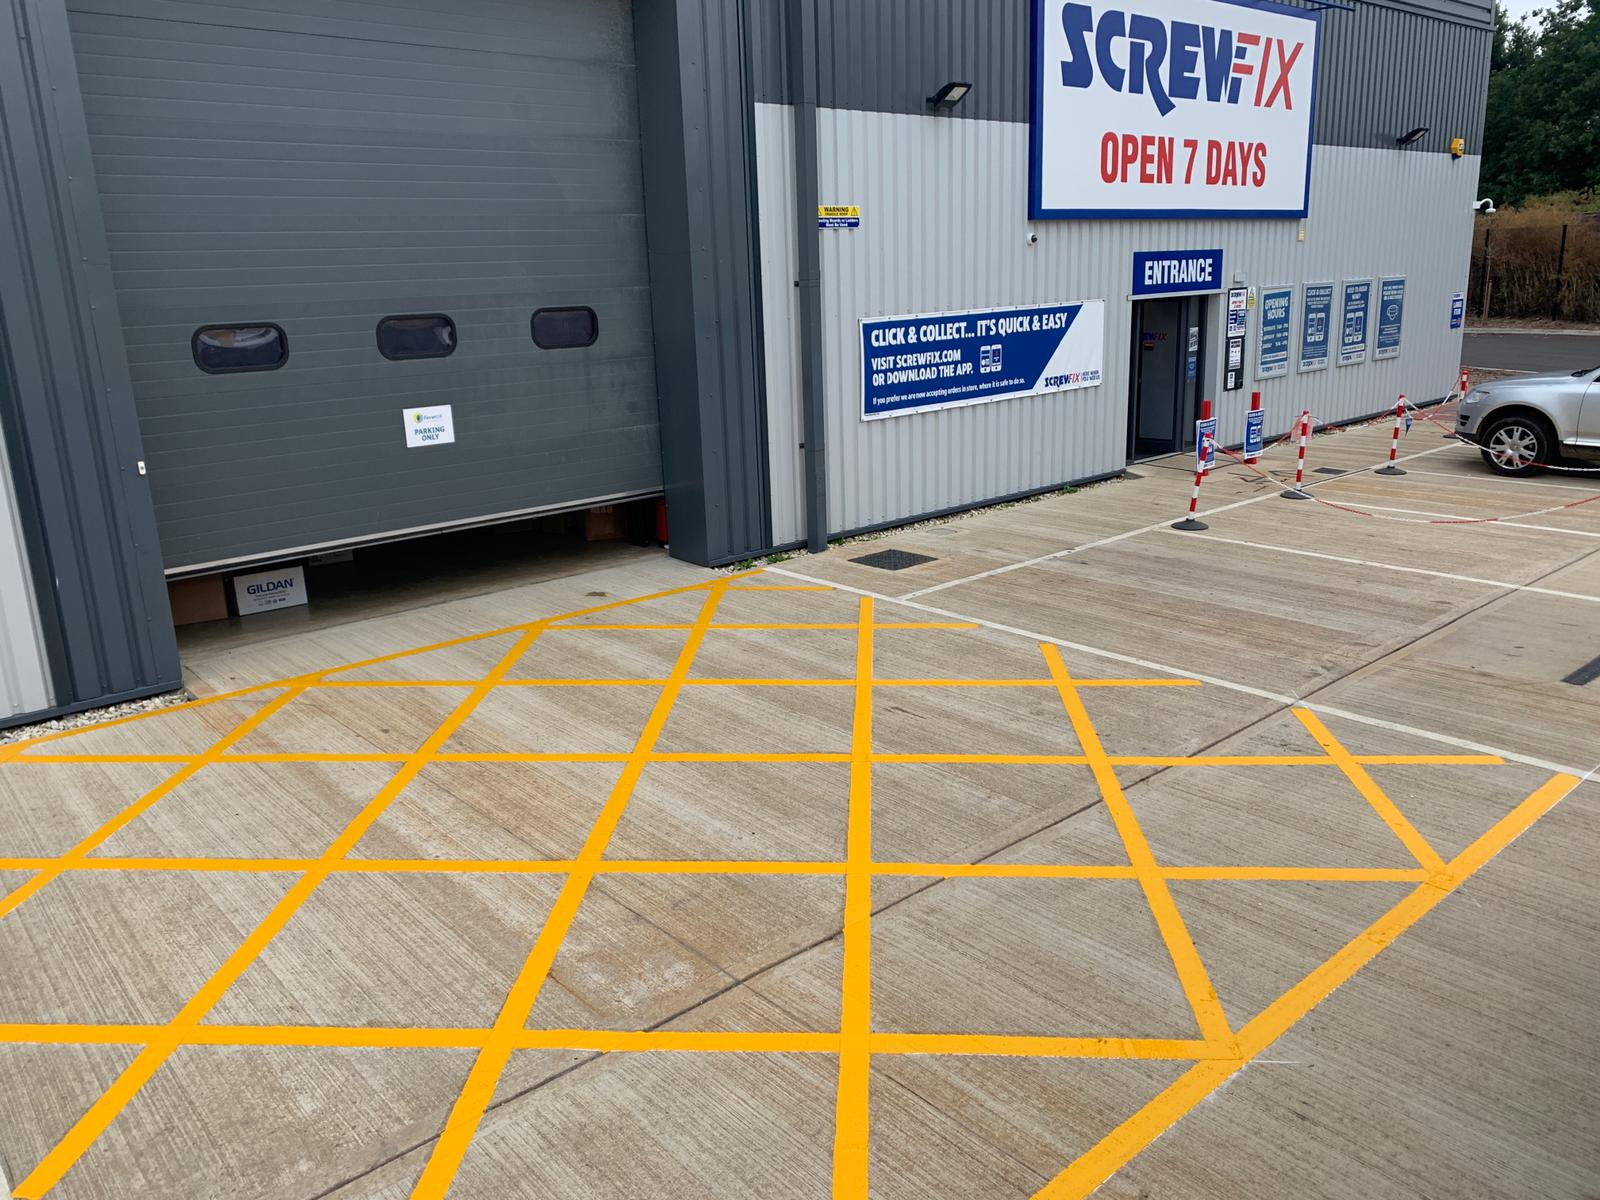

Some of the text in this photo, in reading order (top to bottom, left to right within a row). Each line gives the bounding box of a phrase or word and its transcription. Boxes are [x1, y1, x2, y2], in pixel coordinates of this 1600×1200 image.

[1060, 2, 1304, 117] SCREWFIX
[1100, 131, 1267, 187] OPEN 7 DAYS
[1144, 258, 1213, 285] ENTRANCE
[1264, 297, 1288, 310] OPENING
[1267, 308, 1285, 320] HOURS
[871, 312, 1068, 347] CLICK & COLLECT... IT'S QUICK & EASY
[871, 349, 961, 370] VISIT SCREWFIX.COM
[872, 362, 974, 386] OR DOWNLOAD THE APP.
[1044, 372, 1080, 388] SCREWFIX
[877, 397, 886, 405] you
[886, 394, 900, 404] prefer
[926, 388, 947, 397] accepting
[979, 382, 991, 390] where
[414, 426, 445, 435] PARKING
[421, 433, 439, 441] ONLY
[247, 578, 294, 595] GILDAN
